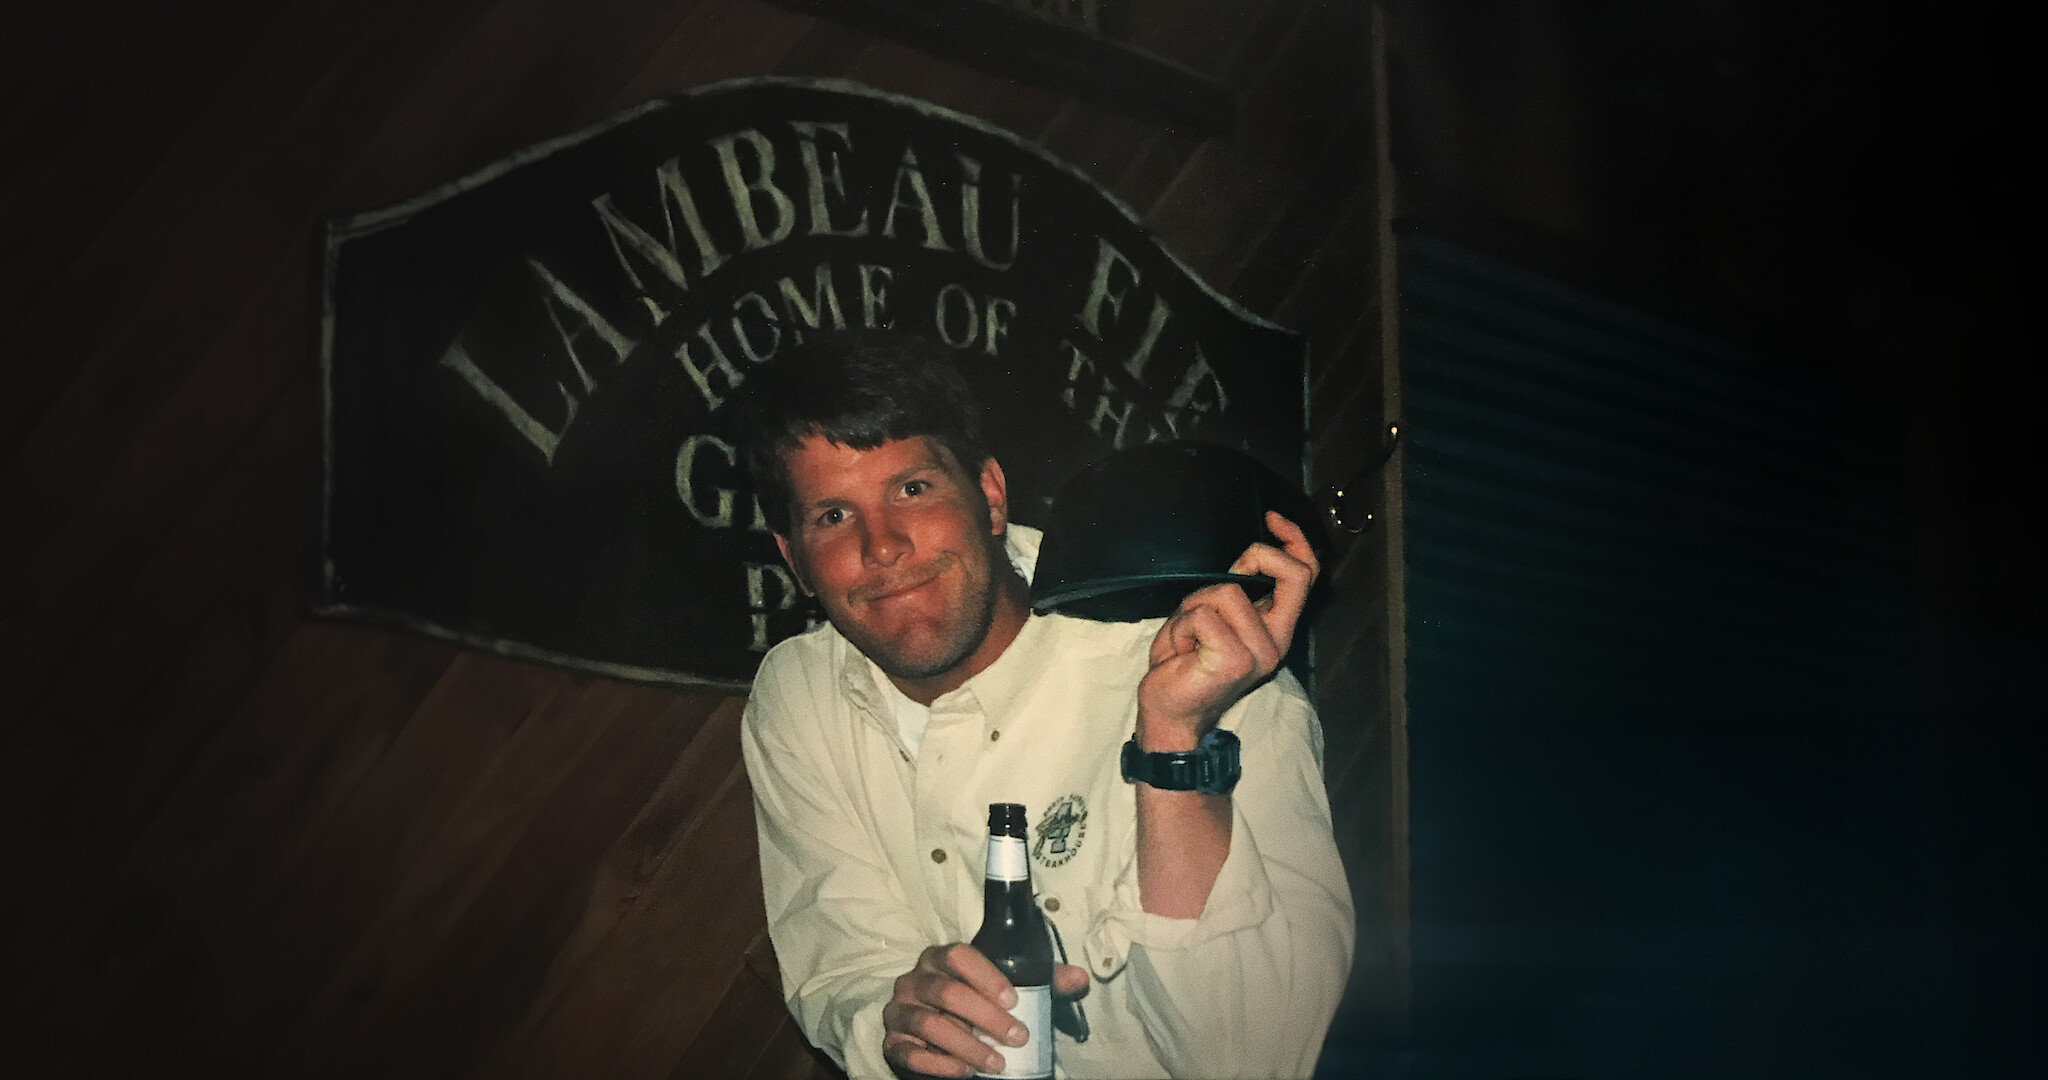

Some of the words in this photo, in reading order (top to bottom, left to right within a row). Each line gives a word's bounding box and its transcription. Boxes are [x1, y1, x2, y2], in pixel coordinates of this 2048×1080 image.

[439, 120, 1023, 467] LAMBEAU
[1075, 236, 1234, 442] FIE
[674, 262, 896, 412] HOME
[935, 283, 1017, 357] OF
[1060, 339, 1158, 450] TH
[1036, 823, 1087, 868] STEAKHOUSE
